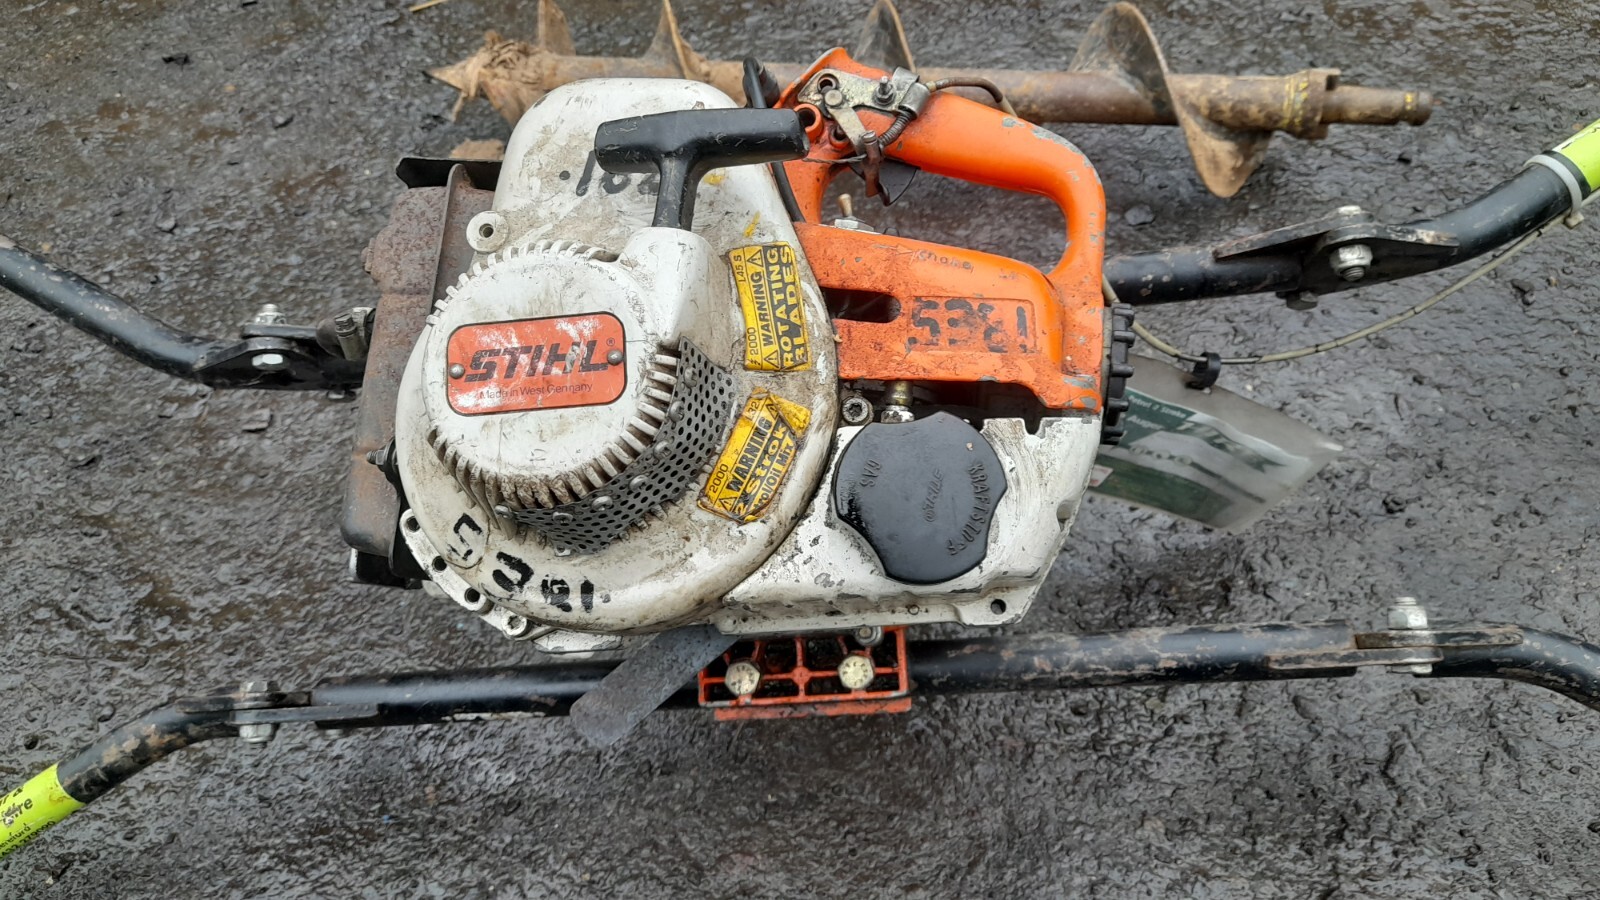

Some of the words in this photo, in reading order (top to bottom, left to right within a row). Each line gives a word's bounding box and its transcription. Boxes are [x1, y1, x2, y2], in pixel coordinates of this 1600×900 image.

[750, 271, 774, 347] WARNING
[766, 247, 795, 367] ROTATING
[781, 246, 808, 361] BLADES
[464, 339, 609, 383] STIHL
[746, 327, 759, 356] 2000
[520, 385, 545, 397] West
[547, 382, 593, 395] Germany
[726, 416, 774, 493] WARNING
[859, 459, 883, 488] GAS
[709, 463, 729, 494] 2000
